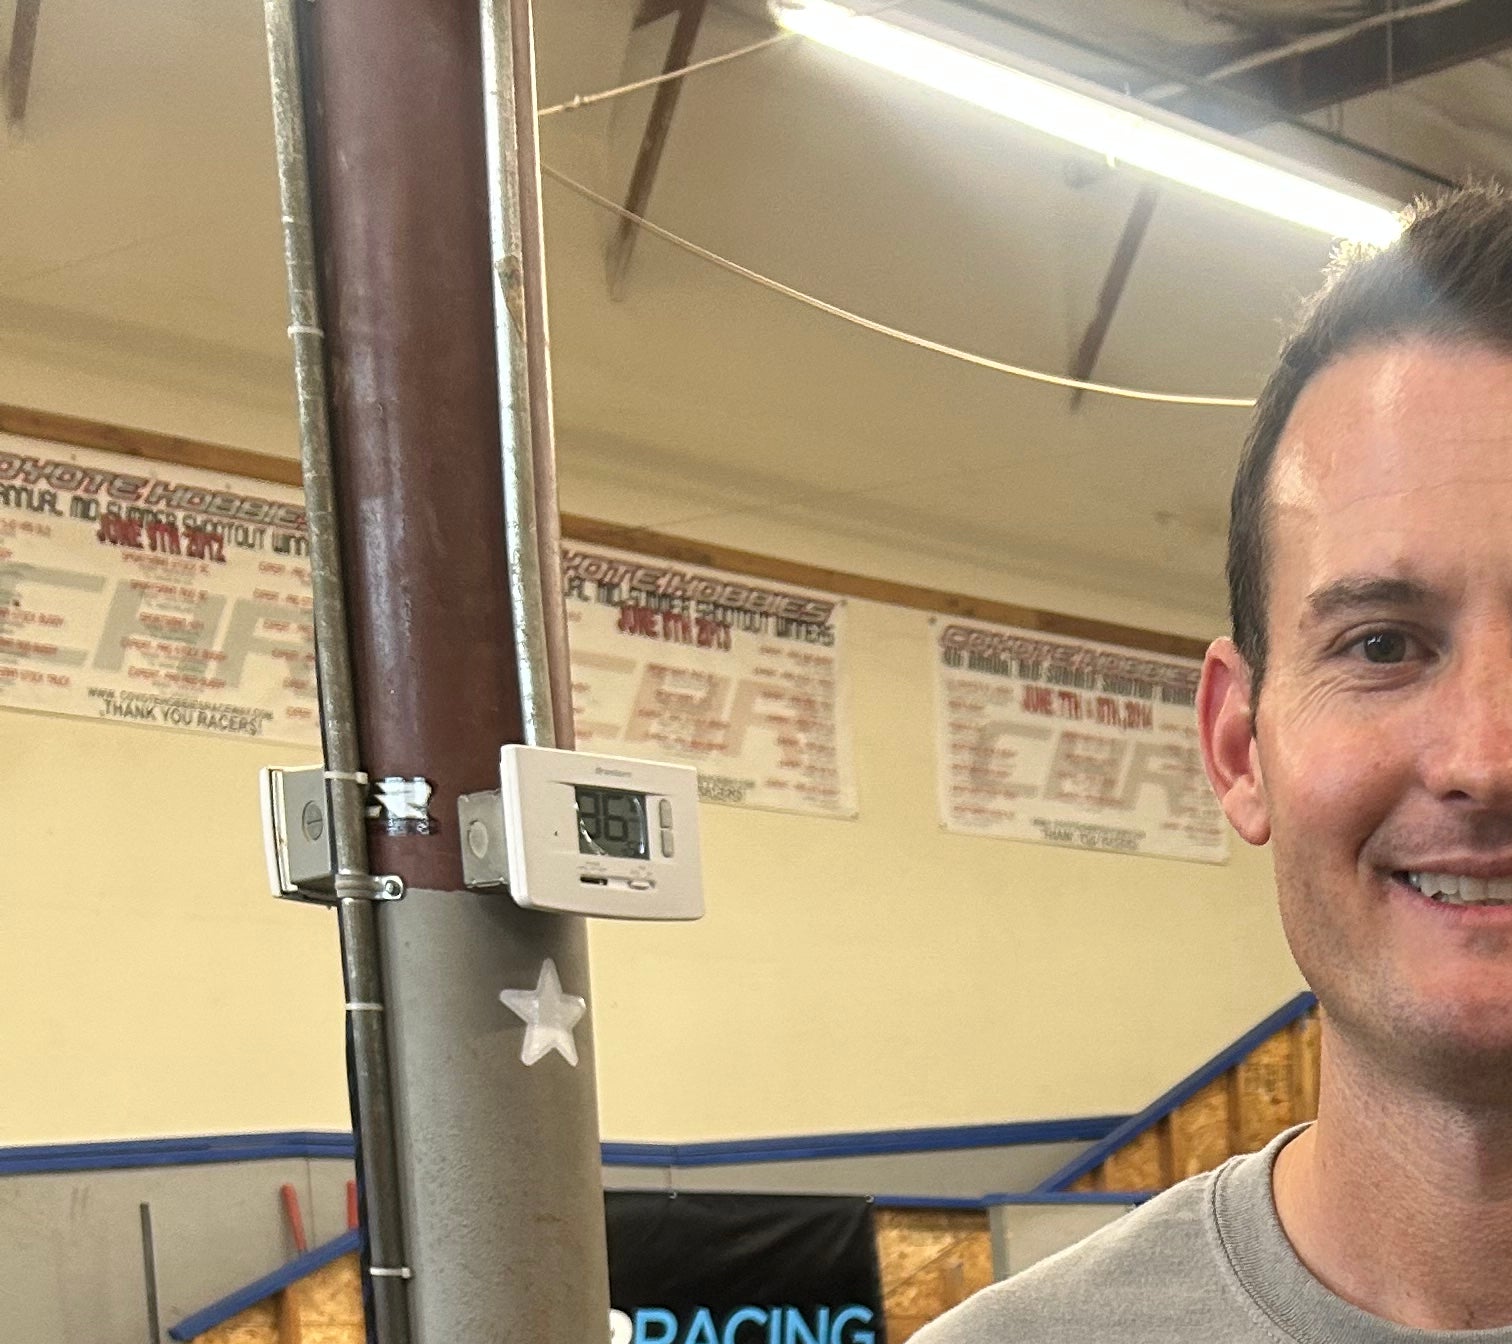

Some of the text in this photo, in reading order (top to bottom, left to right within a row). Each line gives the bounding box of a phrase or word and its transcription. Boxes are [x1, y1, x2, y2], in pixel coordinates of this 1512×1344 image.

[0, 451, 149, 502] OYOTE
[560, 549, 662, 596] YOTE
[103, 699, 155, 722] THANK
[161, 703, 196, 726] YOU
